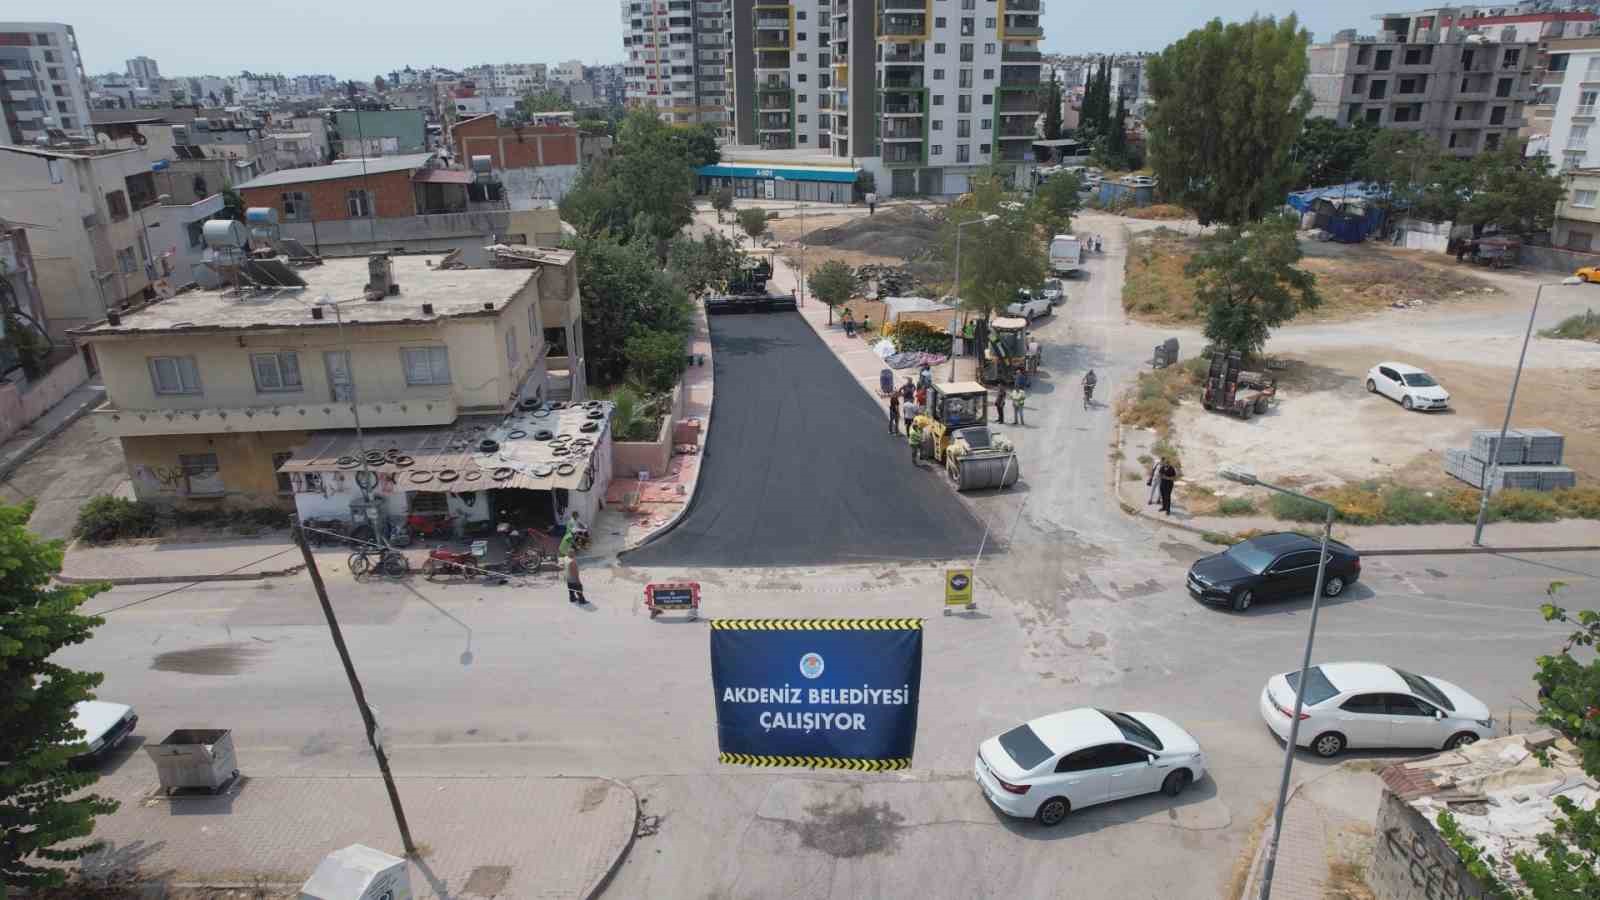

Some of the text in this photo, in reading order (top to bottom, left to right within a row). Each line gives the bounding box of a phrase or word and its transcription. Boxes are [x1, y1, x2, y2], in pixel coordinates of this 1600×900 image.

[723, 683, 909, 705] AKDENİZ BELEDİYESİ
[759, 712, 866, 734] ÇALIŞIYOR
